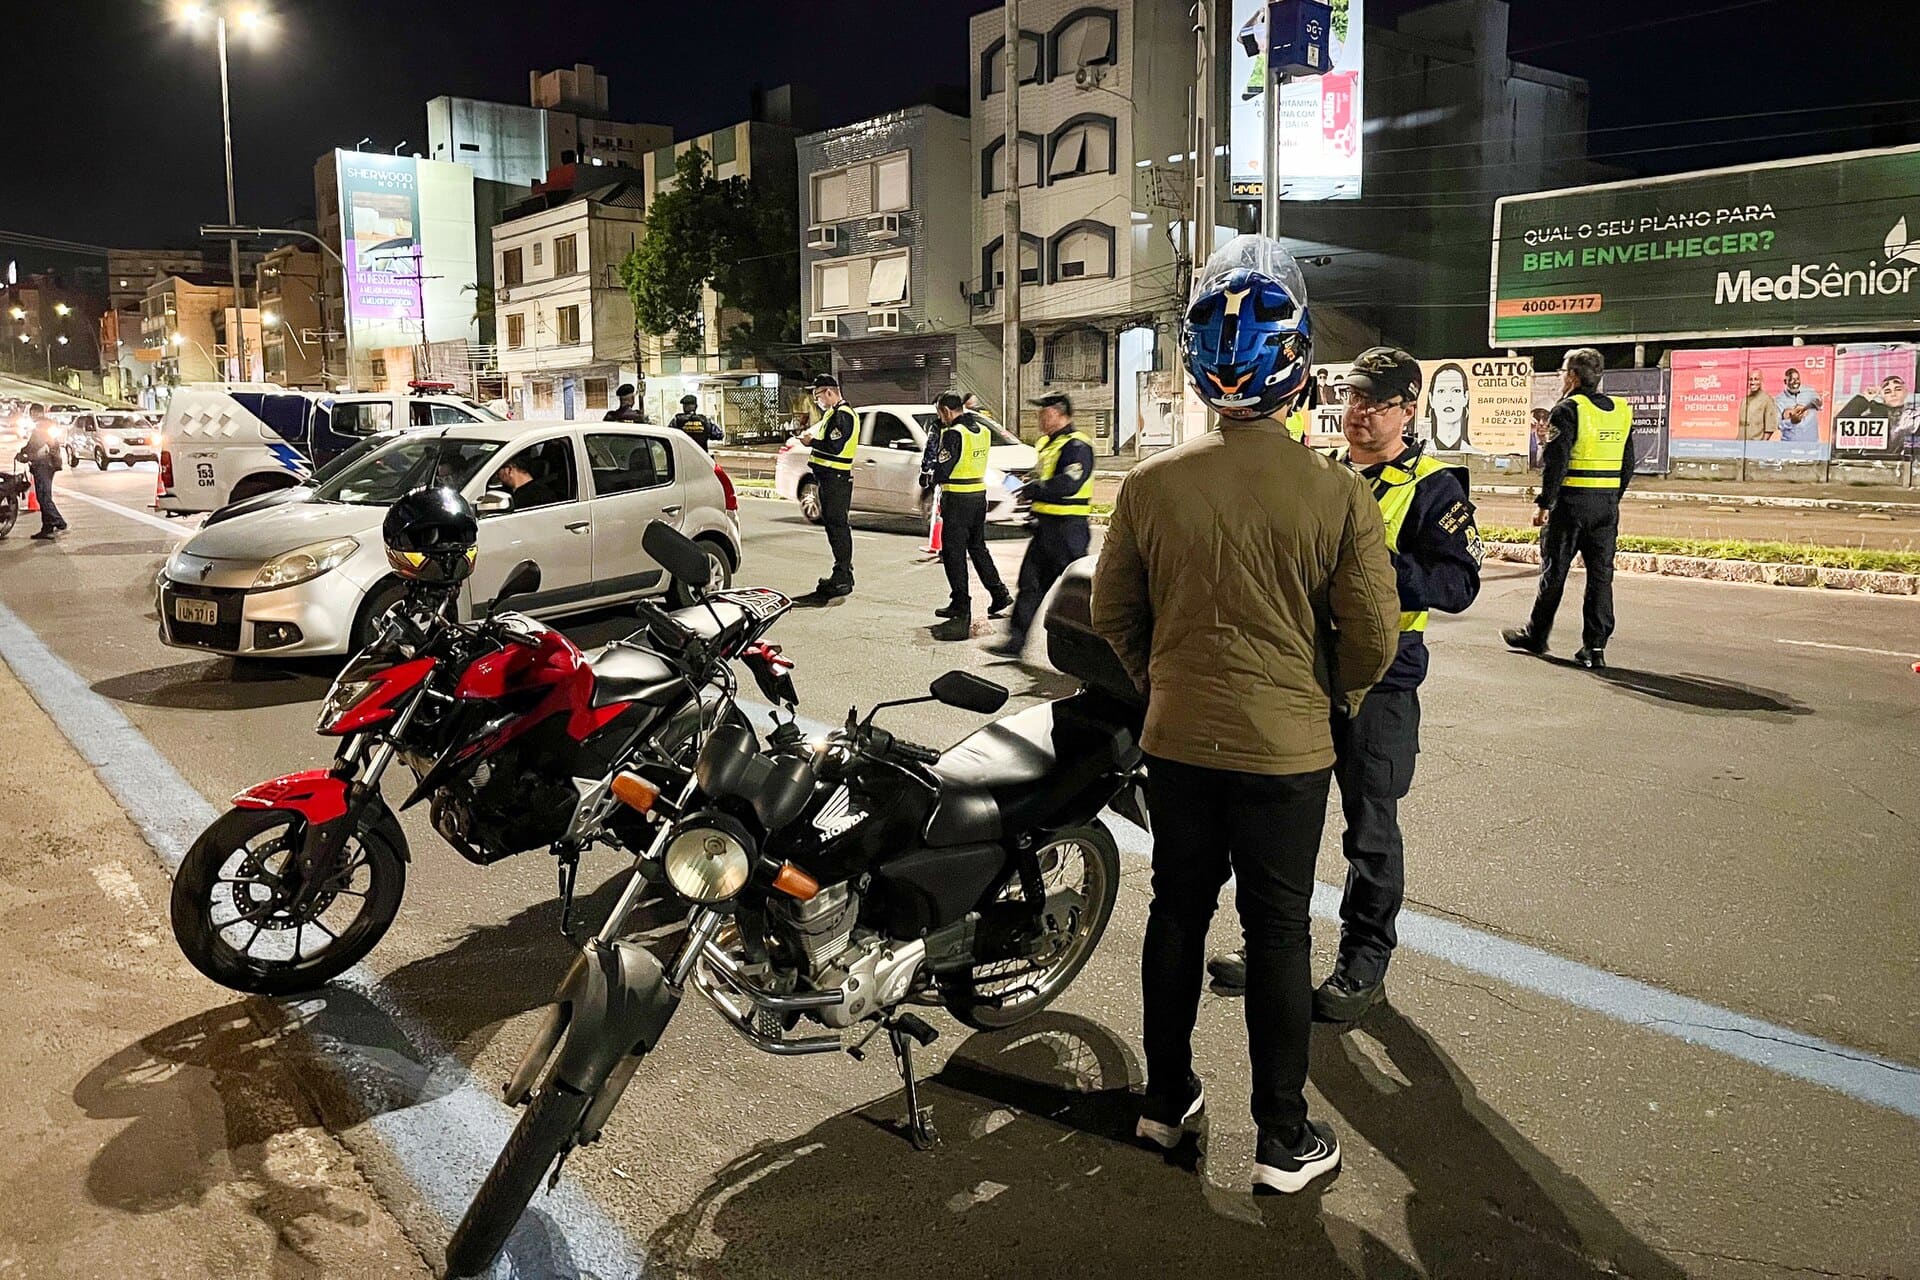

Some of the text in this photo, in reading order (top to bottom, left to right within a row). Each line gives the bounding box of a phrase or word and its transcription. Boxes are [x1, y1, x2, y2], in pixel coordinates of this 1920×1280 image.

[347, 167, 413, 183] SHERWOOD
[378, 180, 413, 190] MOTEL
[1523, 203, 1777, 246] QUAL O SEU PLANO PARA
[1523, 230, 1776, 272] BEM ENVELHECER?
[1714, 260, 1918, 305] MedSênior
[1522, 297, 1595, 313] 4000-1717
[1471, 361, 1528, 377] CATTO
[1804, 356, 1826, 369] 03
[1477, 377, 1508, 388] canta
[1679, 393, 1736, 402] THIAGUINHO
[1684, 402, 1729, 412] PÉRICLES
[1840, 420, 1884, 437] 13.DEZ
[197, 469, 214, 479] 153
[198, 479, 215, 487] GM
[818, 810, 870, 843] HONDA
